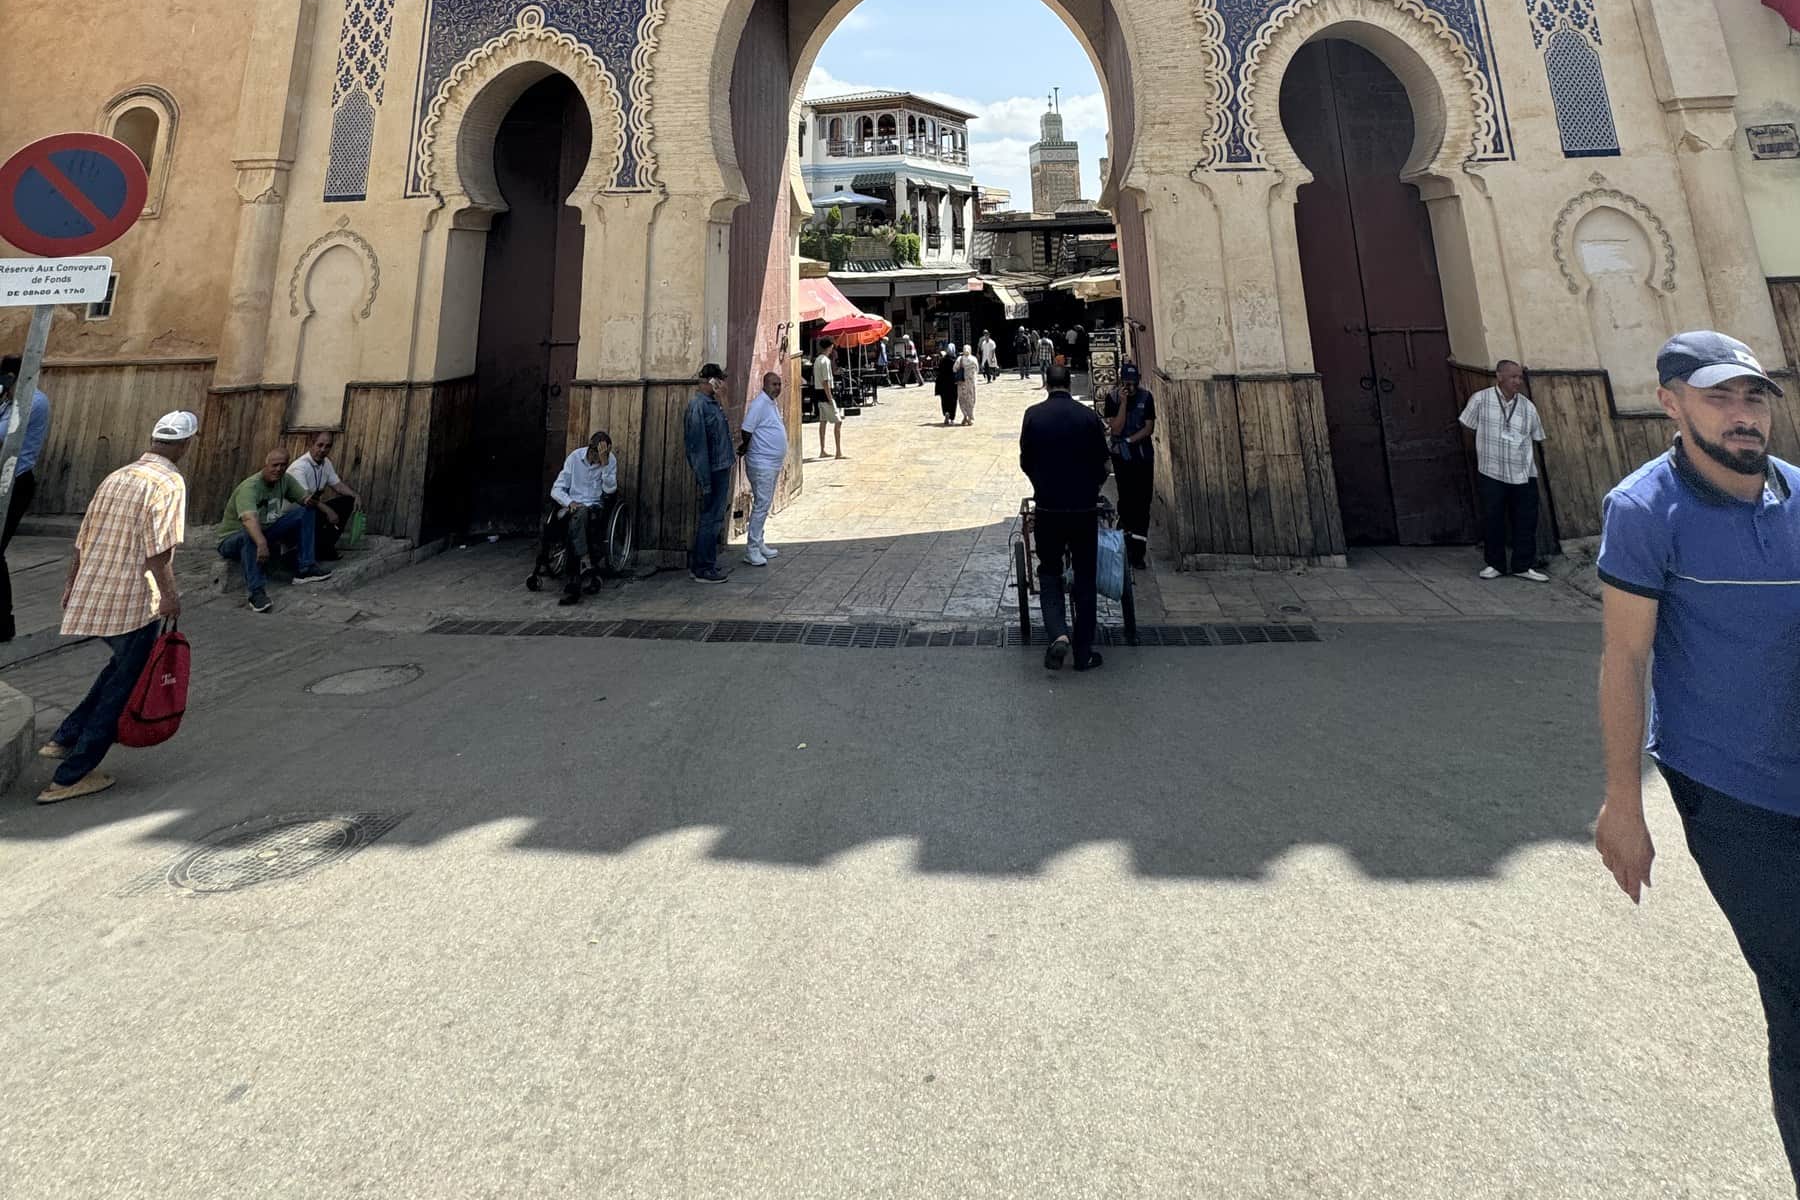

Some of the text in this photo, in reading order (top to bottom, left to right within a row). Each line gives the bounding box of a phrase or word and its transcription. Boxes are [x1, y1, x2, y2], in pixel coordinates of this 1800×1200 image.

[36, 264, 54, 273] Aux
[31, 275, 72, 284] de Fonds
